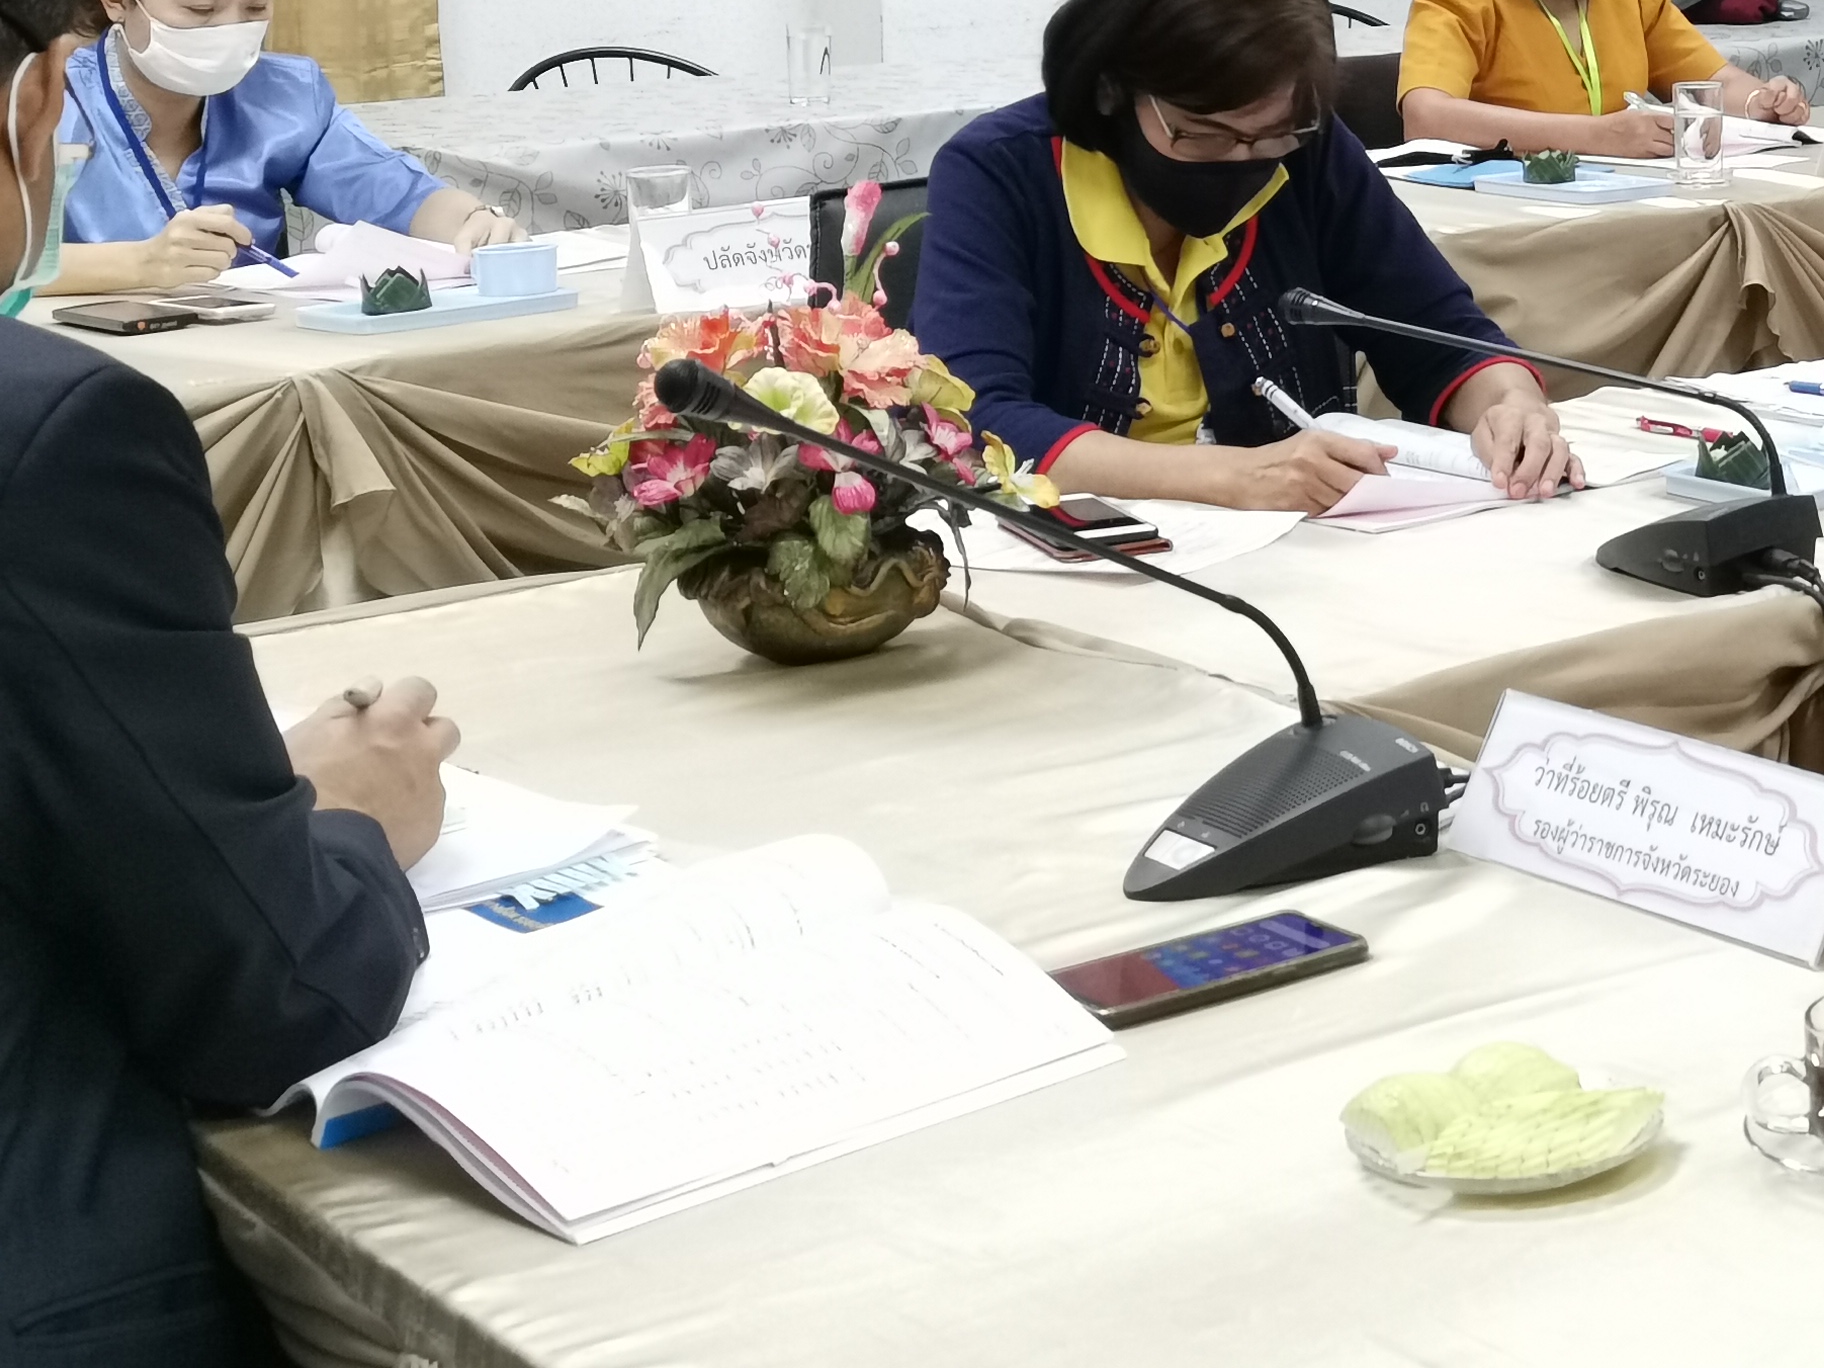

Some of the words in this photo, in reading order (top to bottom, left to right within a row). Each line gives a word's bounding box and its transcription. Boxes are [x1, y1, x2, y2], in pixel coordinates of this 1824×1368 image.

[702, 237, 811, 271] ปลัดจังหวัด
[1533, 756, 1631, 812] ว่าที่ร้อยตรี
[1632, 785, 1679, 833] พิรุณ
[1689, 811, 1788, 857] เหมะรักษ์
[1531, 816, 1741, 901] รองผู้ว่าราชการจังหวัดระยอง
